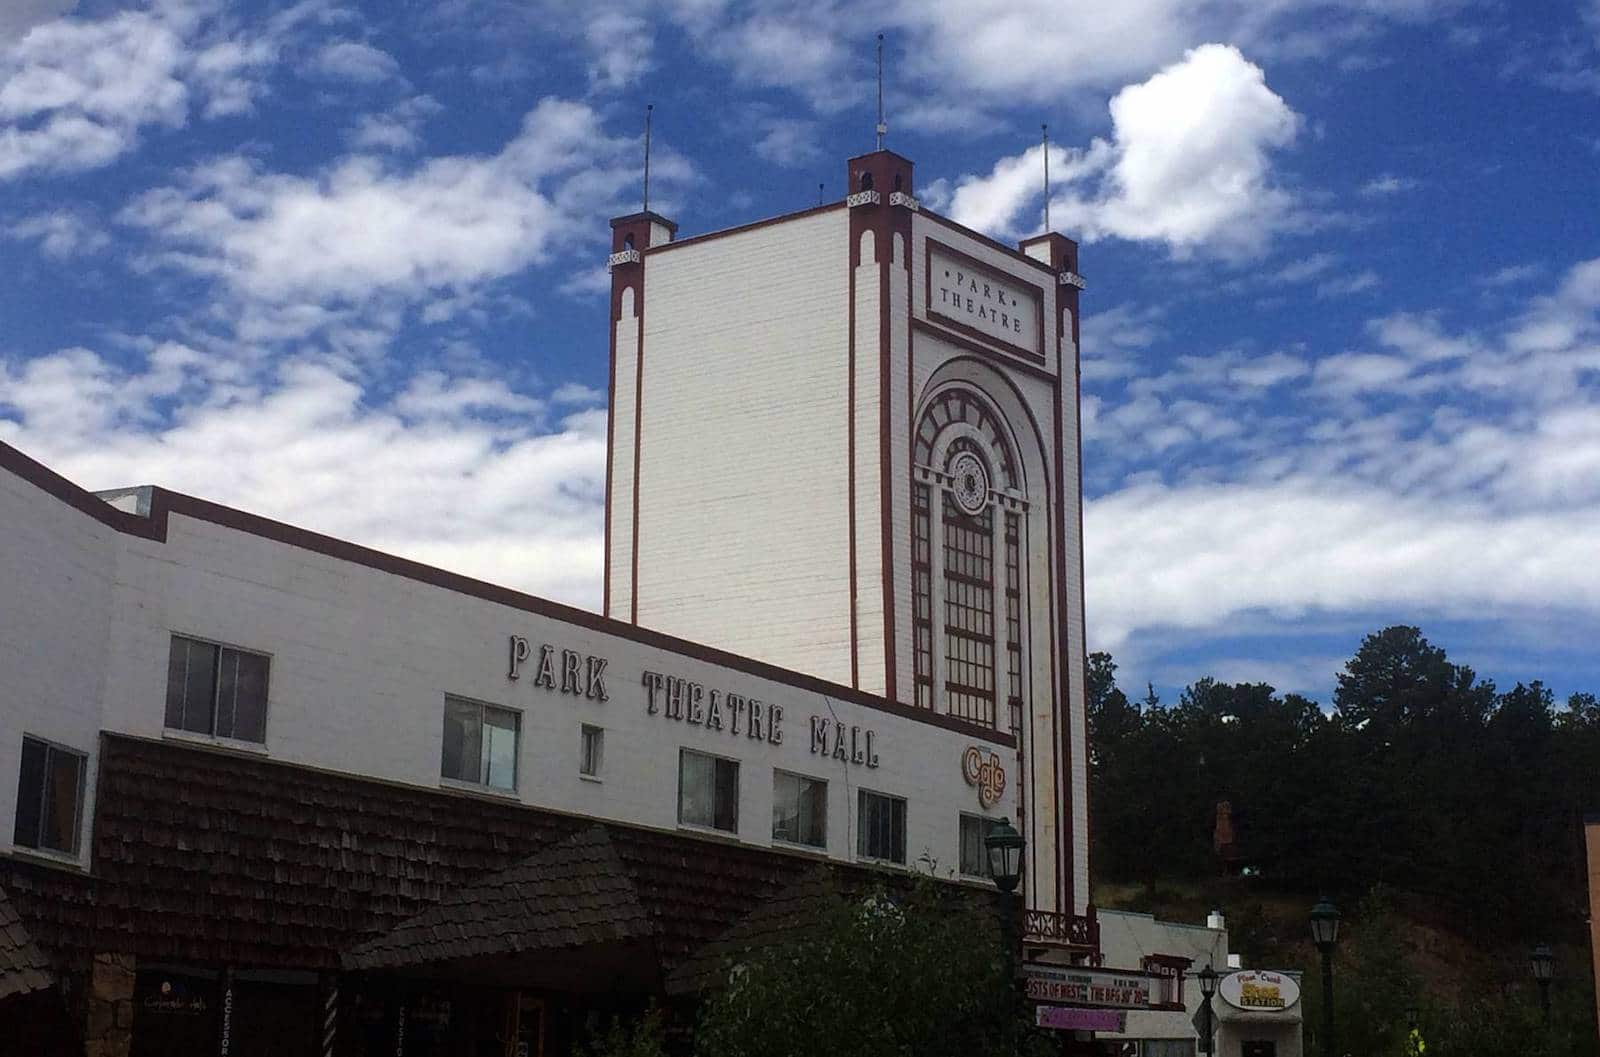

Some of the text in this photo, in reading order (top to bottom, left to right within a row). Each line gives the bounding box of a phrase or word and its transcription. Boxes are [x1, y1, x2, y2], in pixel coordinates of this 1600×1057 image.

[940, 287, 1022, 333] THEATRE
[956, 270, 1008, 307] PARK
[508, 634, 880, 769] PARK THEATRE MALL
[221, 988, 232, 1057] ACCESSOR
[1242, 998, 1284, 1007] STATION
